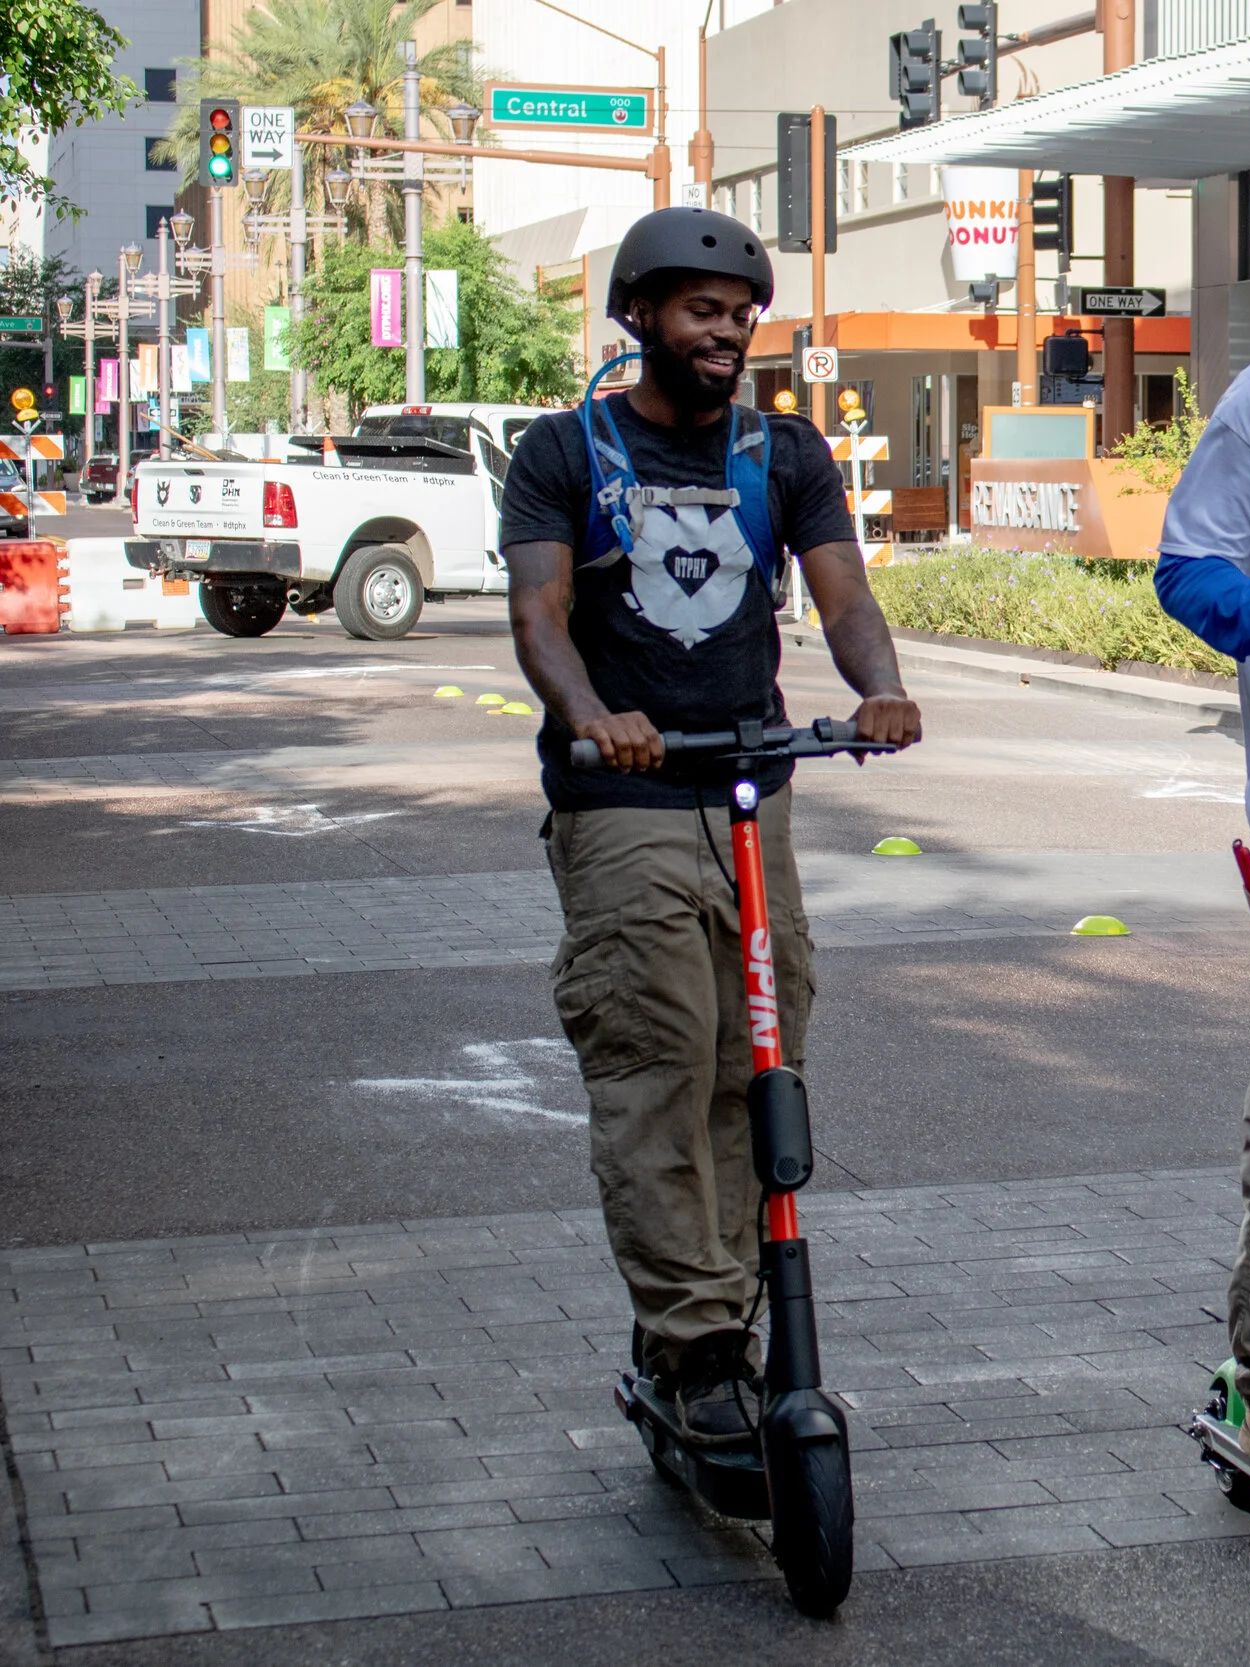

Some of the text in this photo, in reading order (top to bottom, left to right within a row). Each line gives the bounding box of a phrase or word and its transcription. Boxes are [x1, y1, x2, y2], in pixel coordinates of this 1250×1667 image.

[507, 97, 588, 118] Central
[250, 112, 285, 128] ONE
[249, 130, 286, 144] WAY
[689, 188, 700, 198] NO
[1089, 295, 1143, 308] ONE WAY
[312, 471, 342, 481] Clean
[352, 472, 382, 483] Green
[384, 473, 409, 483] Team
[423, 475, 456, 487] #dtphx
[973, 480, 1082, 533] RENAISSANCE
[152, 519, 170, 527] Clean
[177, 519, 196, 528] Green
[196, 520, 214, 529] Team
[223, 521, 247, 531] #dtphx
[748, 928, 778, 1048] SPIN
